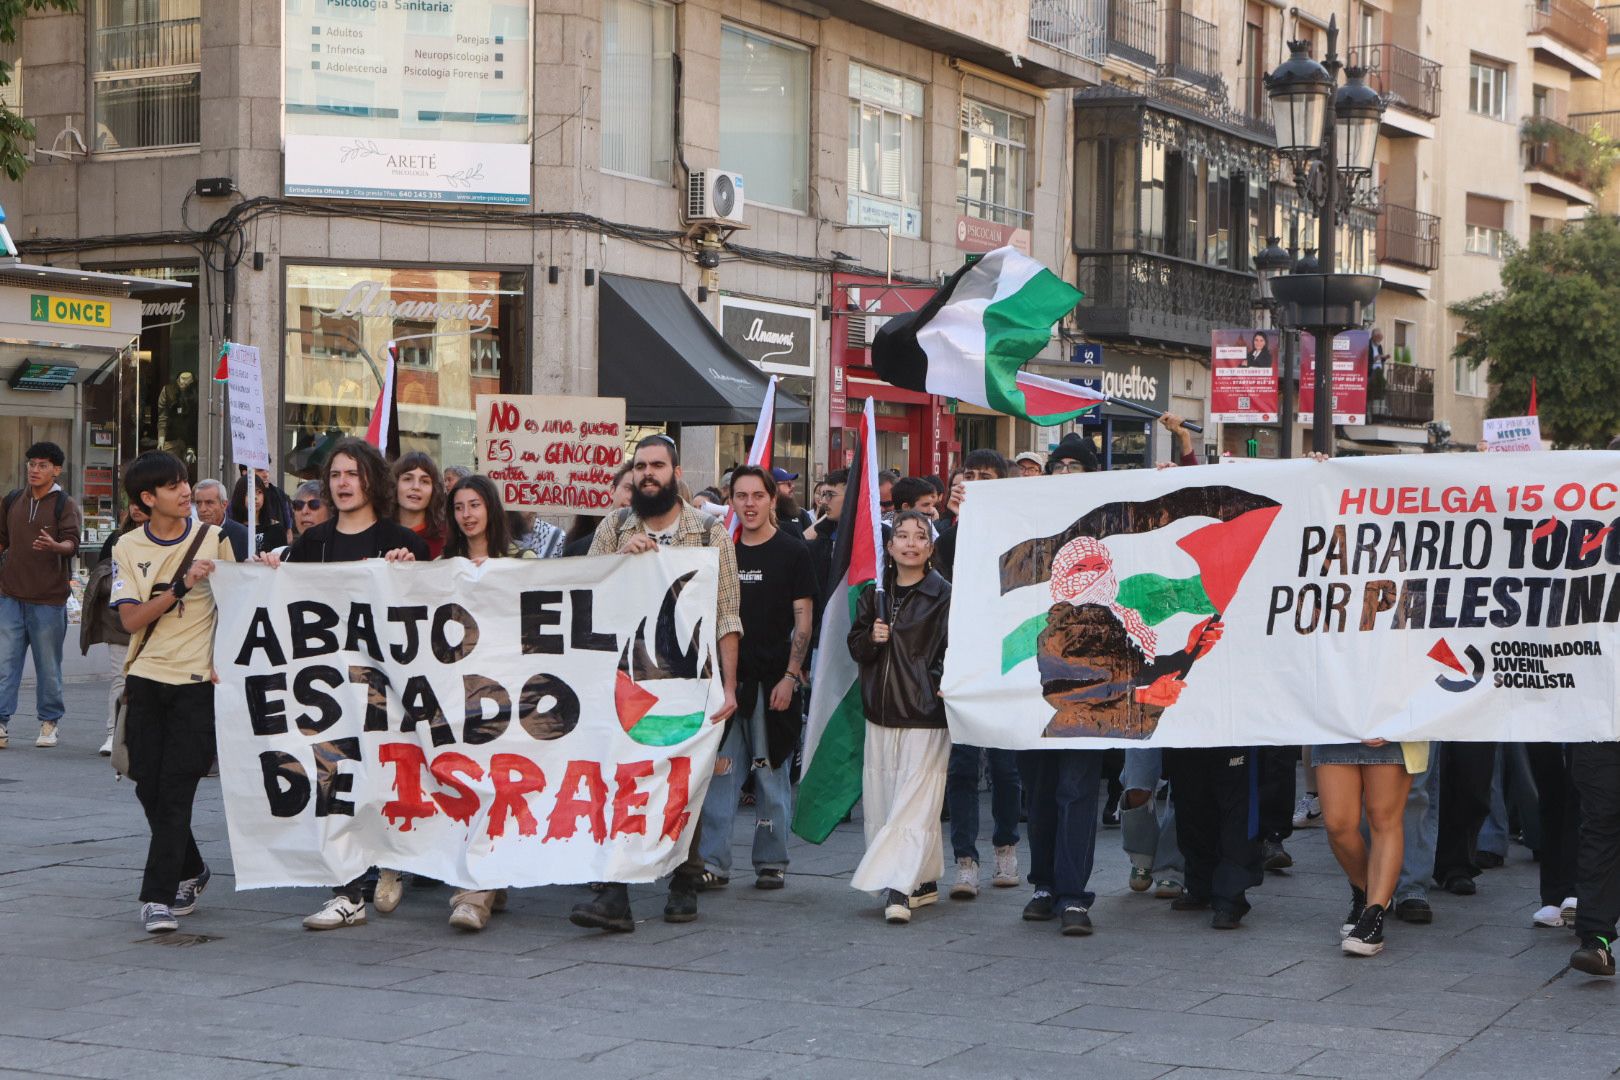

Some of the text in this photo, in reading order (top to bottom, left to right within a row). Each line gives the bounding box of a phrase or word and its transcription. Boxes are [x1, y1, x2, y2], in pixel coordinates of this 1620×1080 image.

[326, 29, 363, 38] Adultos
[456, 34, 490, 45] Parejas
[326, 44, 365, 55] Infancia
[326, 61, 388, 74] Adolescencia
[453, 69, 489, 80] Forense
[387, 153, 437, 169] ARETÉ
[288, 187, 322, 195] Entreplanta
[398, 190, 412, 198] 640
[55, 301, 105, 323] ONCE
[318, 280, 493, 335] Anamont
[743, 318, 794, 358] Anamont
[488, 401, 620, 441] NO es una guerra
[486, 439, 516, 461] ES
[545, 442, 623, 467] GENOCIDIO
[487, 464, 614, 487] contra un pueblo
[1339, 482, 1618, 516] HUELGA 15 OC
[1298, 518, 1492, 577] PARARLO
[1266, 582, 1352, 636] POR
[234, 589, 618, 667] ABAJO EL
[1491, 641, 1602, 658] COORDINADORA
[1492, 657, 1549, 674] JUVENIL
[1494, 673, 1576, 689] SOCIALISTA
[245, 664, 580, 747] ESTADO
[258, 736, 692, 846] DE ISRAEL
